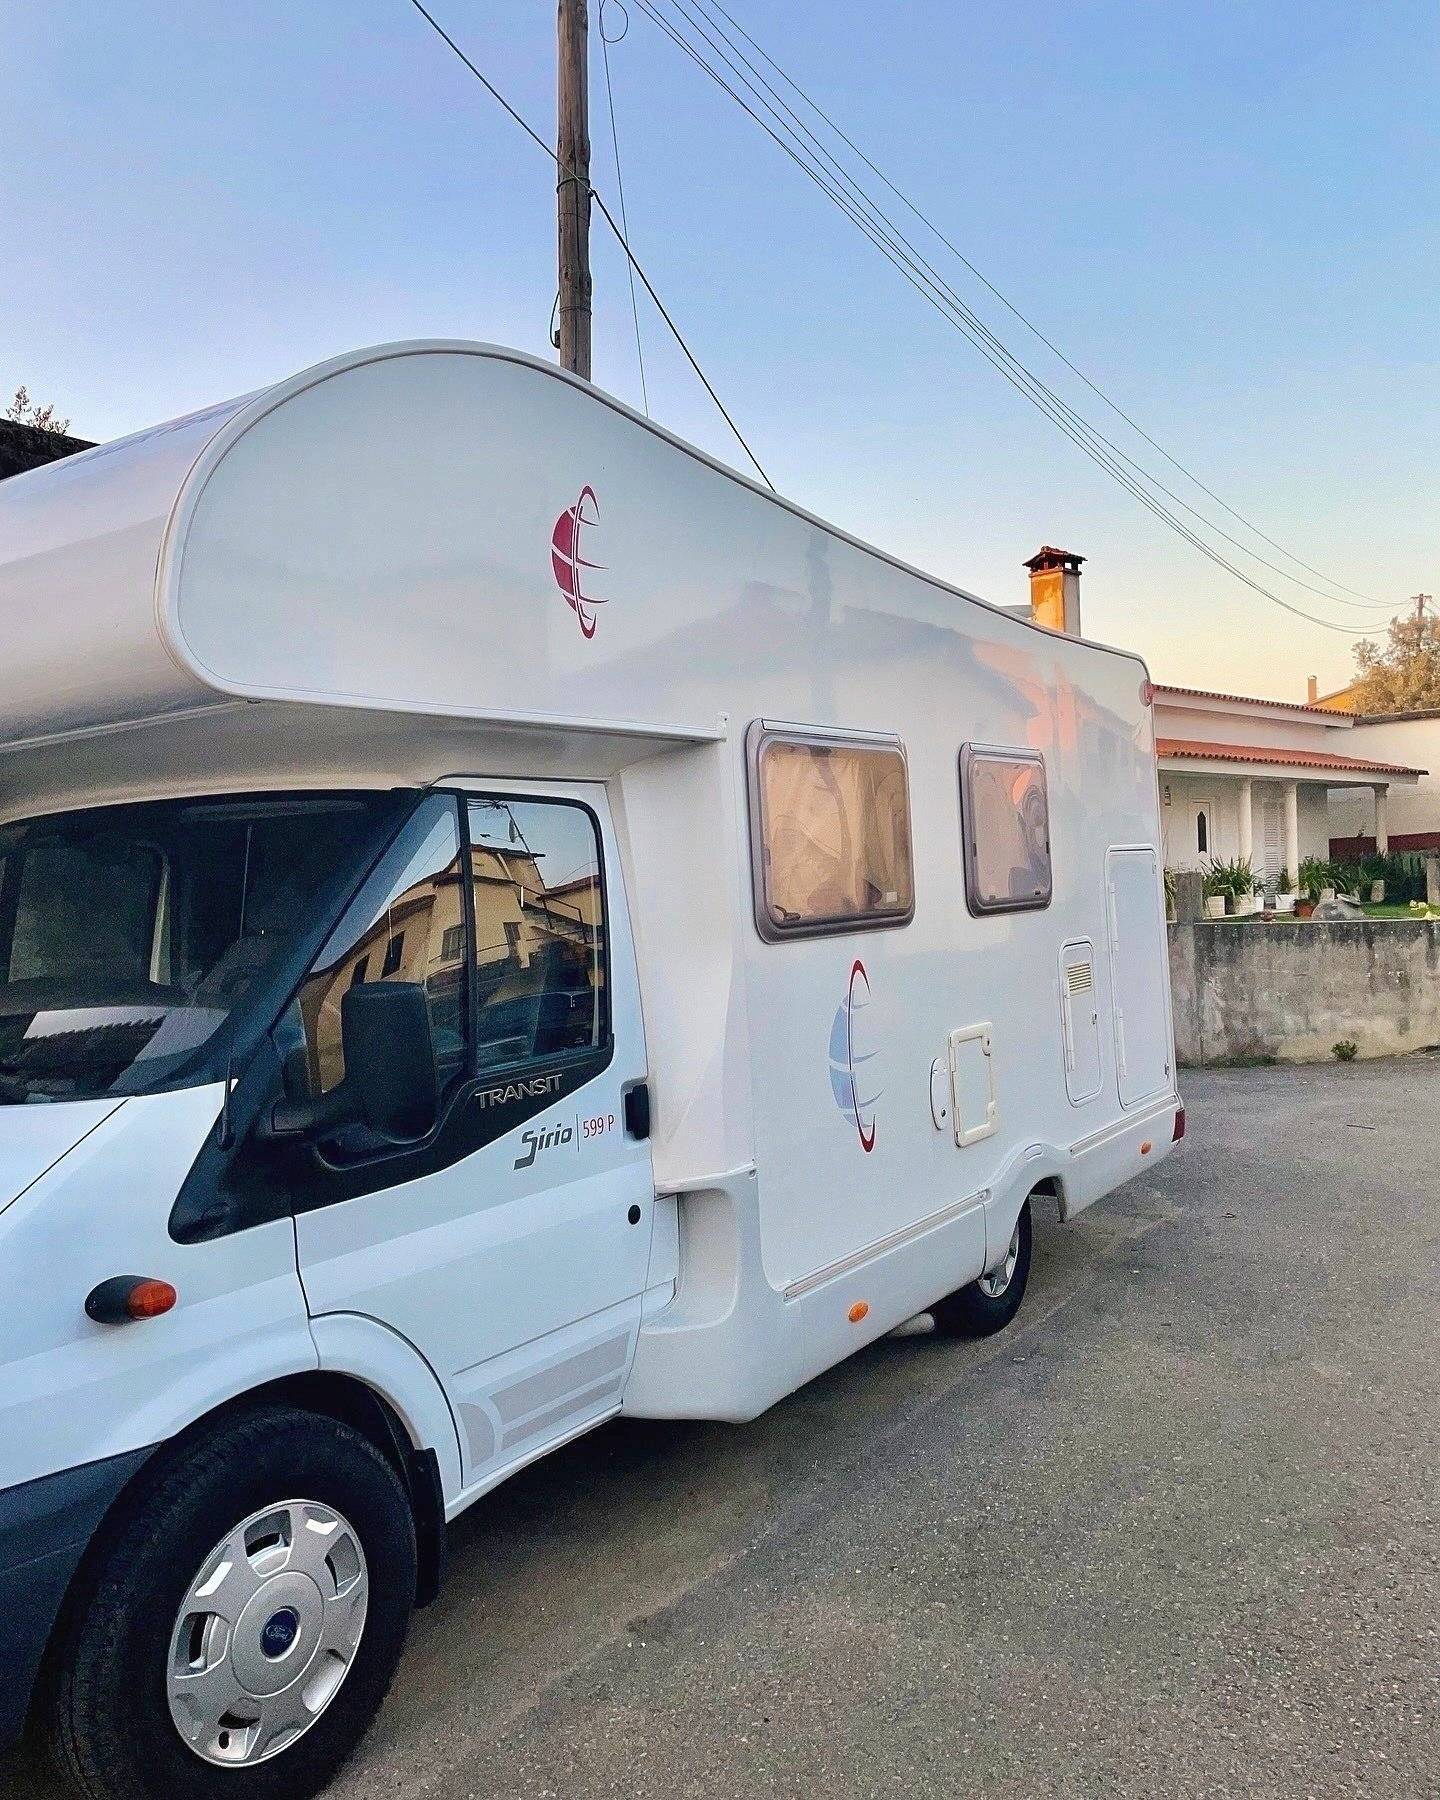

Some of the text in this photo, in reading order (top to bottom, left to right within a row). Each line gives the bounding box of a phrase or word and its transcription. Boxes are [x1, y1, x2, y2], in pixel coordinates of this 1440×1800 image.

[475, 1073, 563, 1109] TRANSIT
[514, 1114, 615, 1171] Sirio 599 P
